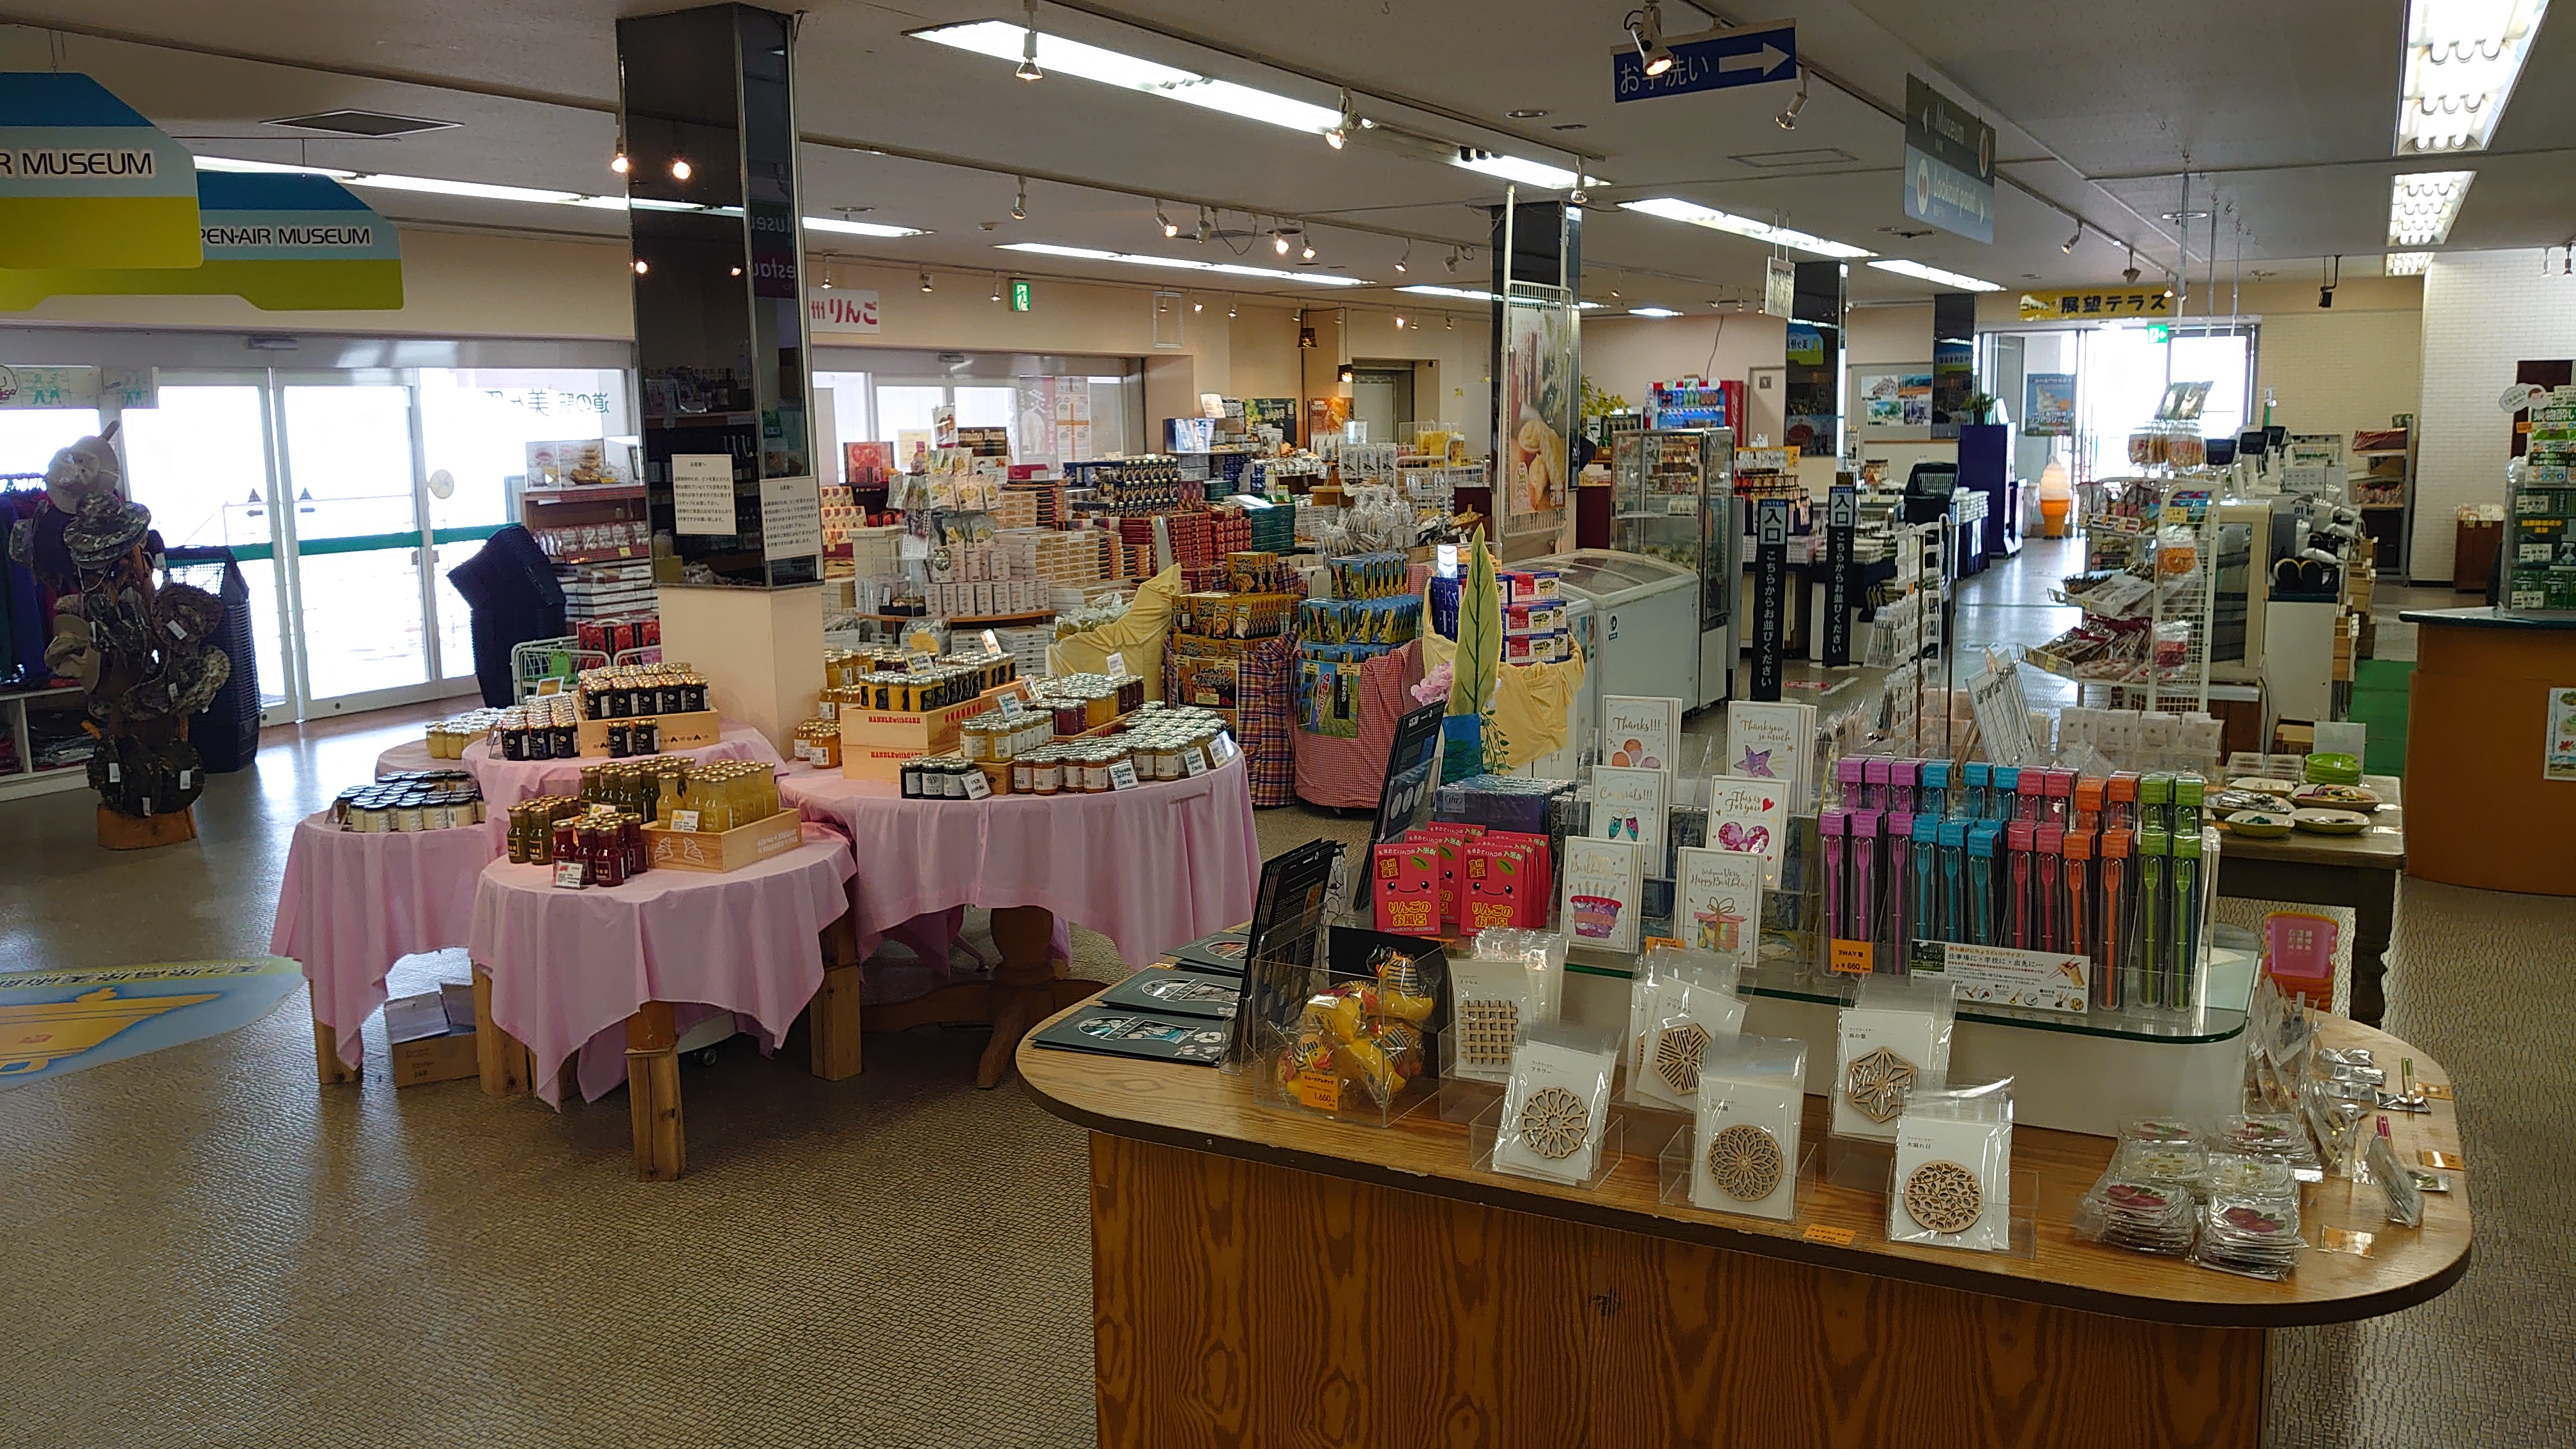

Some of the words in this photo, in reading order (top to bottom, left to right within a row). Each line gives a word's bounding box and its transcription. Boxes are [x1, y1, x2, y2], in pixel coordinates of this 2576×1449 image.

[22, 153, 153, 174] MUSEUM
[279, 228, 371, 244] MUSEUM
[2061, 295, 2166, 314] 展望テラス
[1834, 494, 1850, 525] 入口
[1765, 509, 1782, 542] 入口
[1832, 532, 1845, 654] こちらからお並びください
[1761, 551, 1775, 687] こちらからお並びください
[1613, 717, 1661, 732] Thanks!!!
[1448, 795, 1460, 805] ihr
[1732, 790, 1752, 805] This
[1380, 859, 1396, 868] 信州
[1469, 859, 1485, 869] 信州
[1382, 868, 1399, 878] 限定
[1469, 868, 1486, 878] 限定
[1388, 901, 1431, 914] りんごの
[1472, 902, 1514, 916] りんごの
[1392, 914, 1427, 926] お風呂
[1475, 917, 1508, 927] お風呂
[1112, 1021, 1138, 1038] VASE
